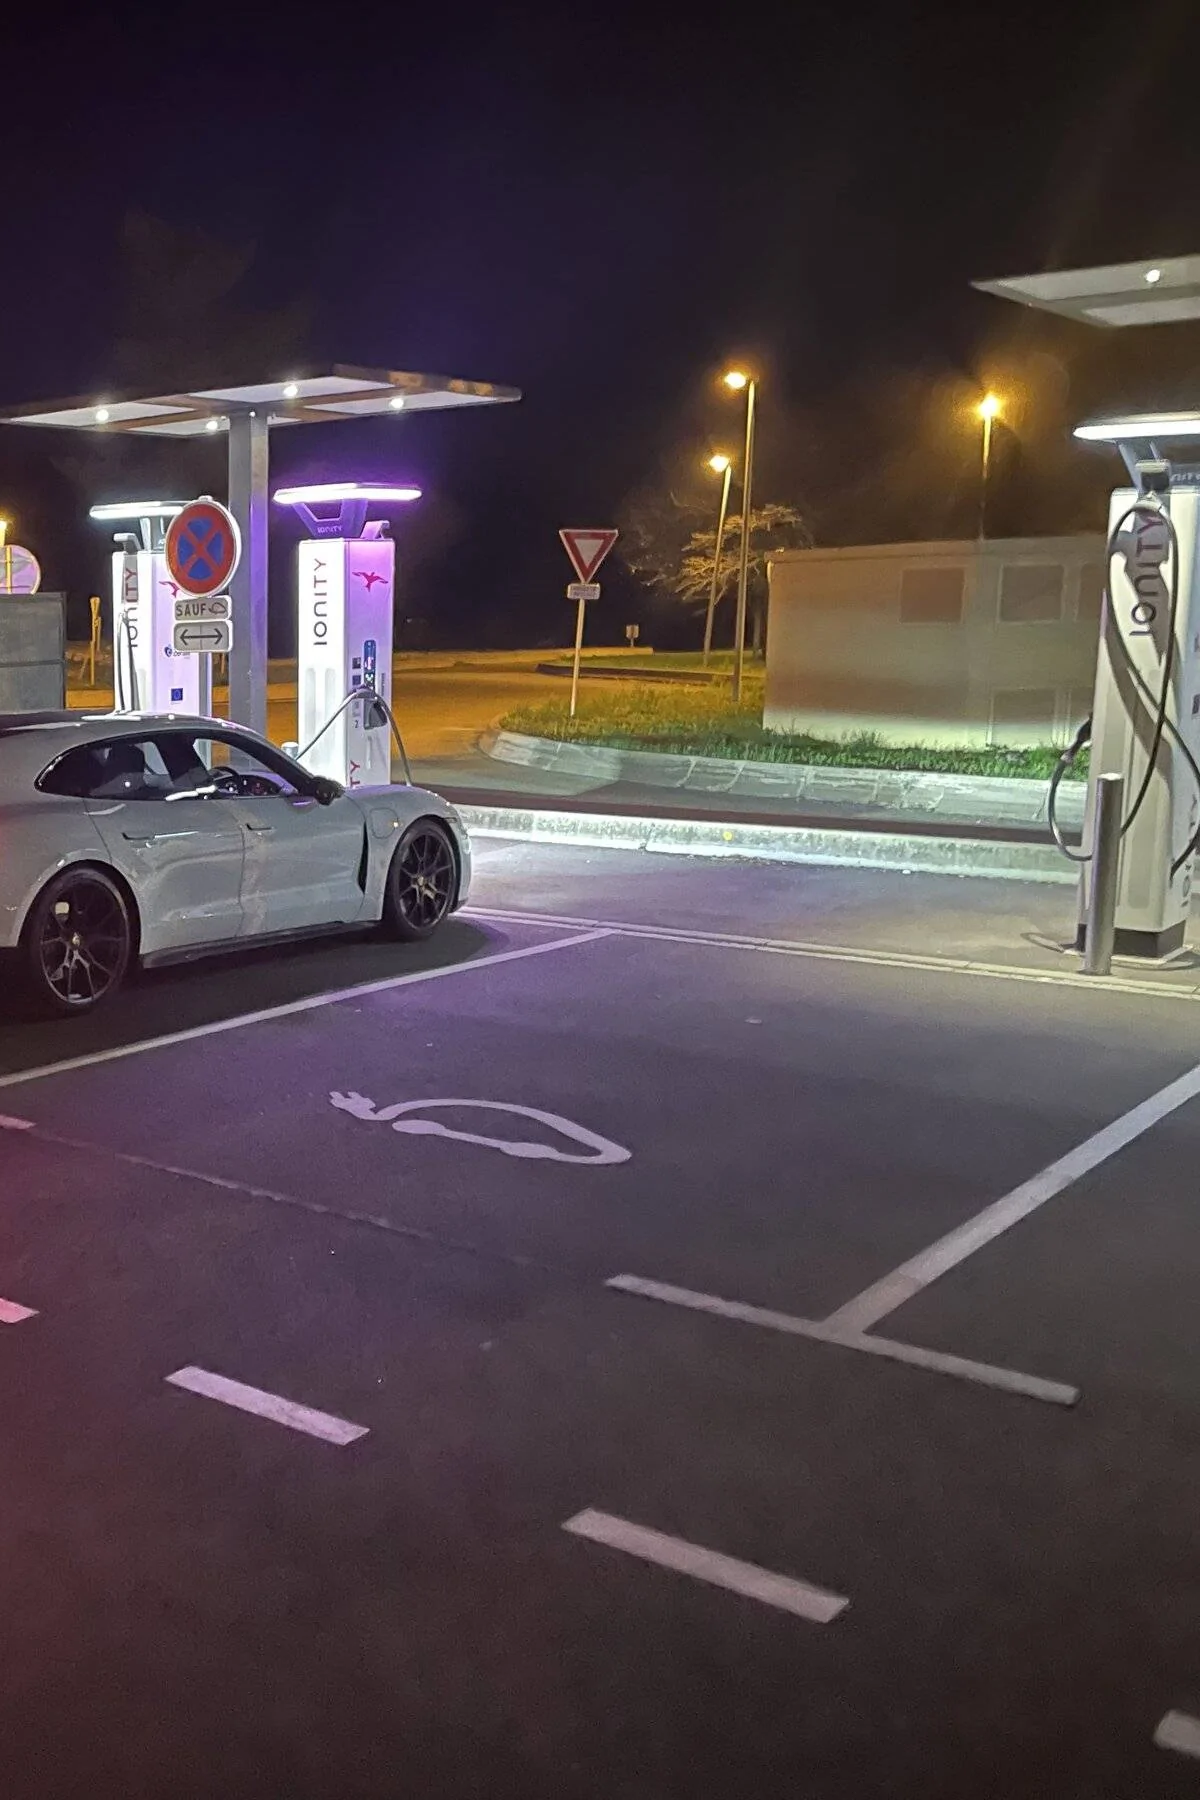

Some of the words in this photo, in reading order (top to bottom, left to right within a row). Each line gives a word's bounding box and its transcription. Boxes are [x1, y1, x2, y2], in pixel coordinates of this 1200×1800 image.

[176, 603, 206, 616] SAUF
[313, 558, 327, 645] IONITY
[1129, 515, 1163, 635] IONITY
